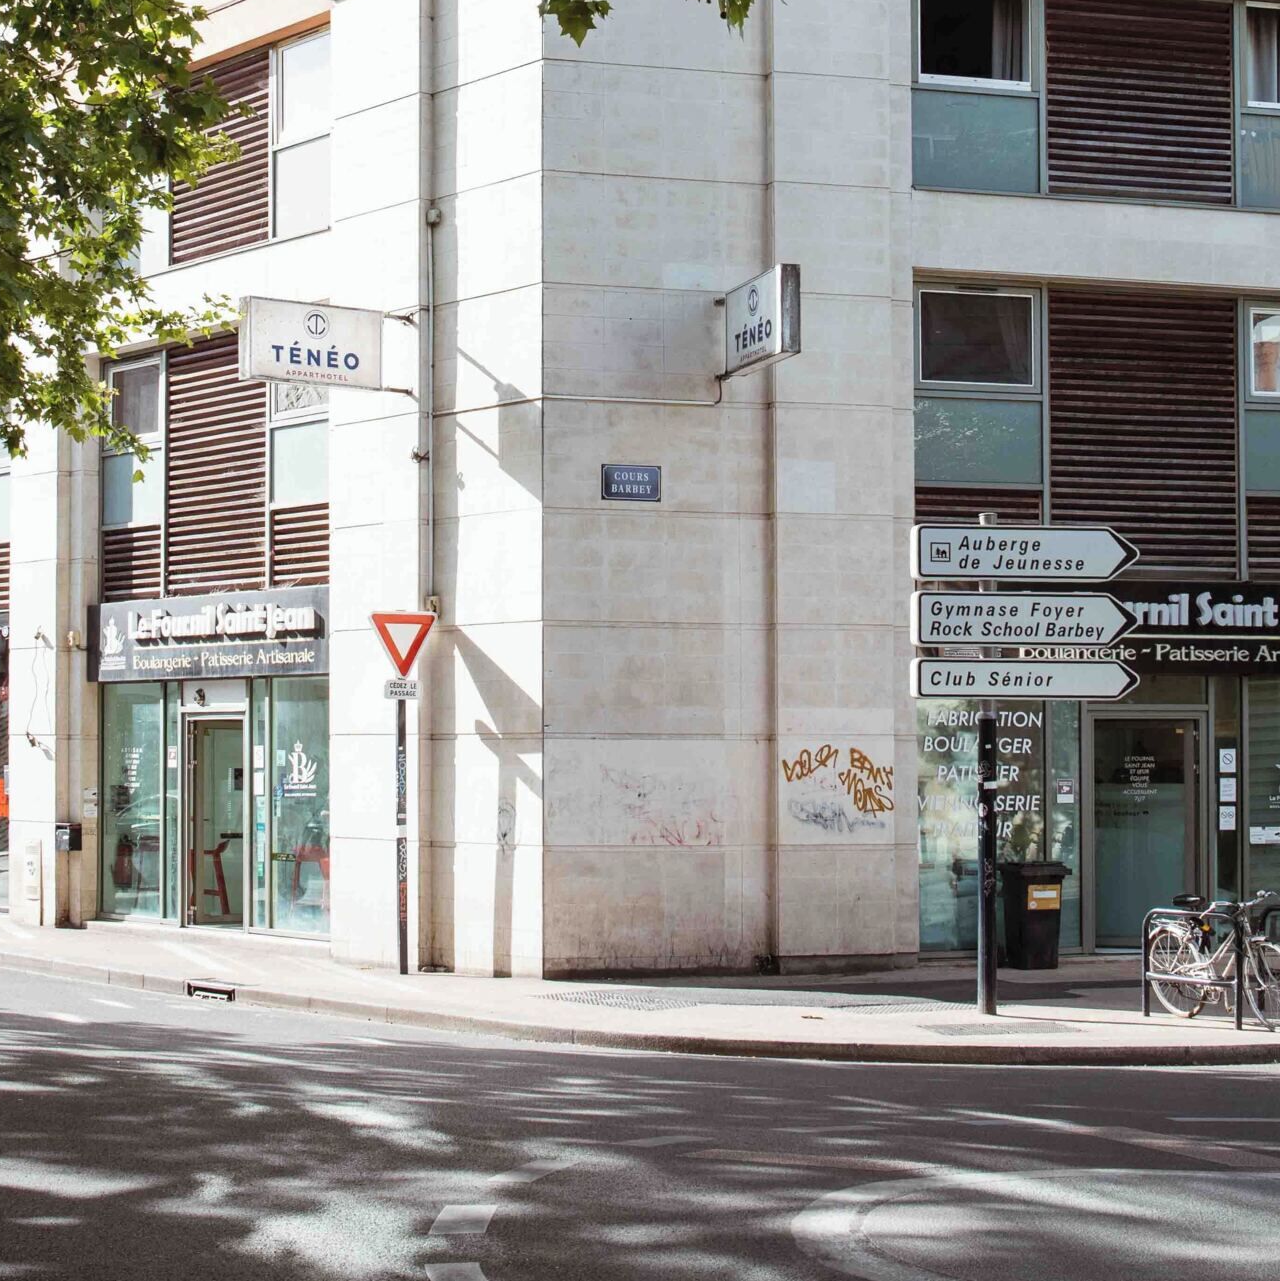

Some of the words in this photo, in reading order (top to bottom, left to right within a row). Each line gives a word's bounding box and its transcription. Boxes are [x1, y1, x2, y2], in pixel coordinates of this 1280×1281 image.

[734, 316, 772, 353] TÉNÉO
[271, 340, 360, 370] TÉNÉO
[286, 369, 349, 382] APPARTHOTEL
[614, 471, 649, 482] COURS
[611, 483, 652, 494] BARBEY
[958, 535, 1041, 556] Auberge
[959, 554, 981, 570] de
[993, 555, 1085, 571] Jeunesse
[930, 601, 1019, 620] Gymnase
[1030, 602, 1085, 621] Foyer
[1195, 591, 1279, 628] Saint
[151, 605, 215, 639] Fournil
[216, 602, 266, 637] Saint
[266, 602, 315, 639] Jean
[930, 621, 973, 637] Rock
[980, 621, 1040, 637] School
[1045, 622, 1105, 641] Barbey
[133, 654, 192, 672] Boulangerie
[201, 651, 253, 667] Patisserie
[256, 648, 315, 665] Artisanale
[1154, 643, 1250, 662] Patisserie
[930, 670, 976, 686] Club
[988, 671, 1054, 687] Sénior
[927, 711, 1043, 728] FABRITION
[923, 736, 1032, 754] BOULGER
